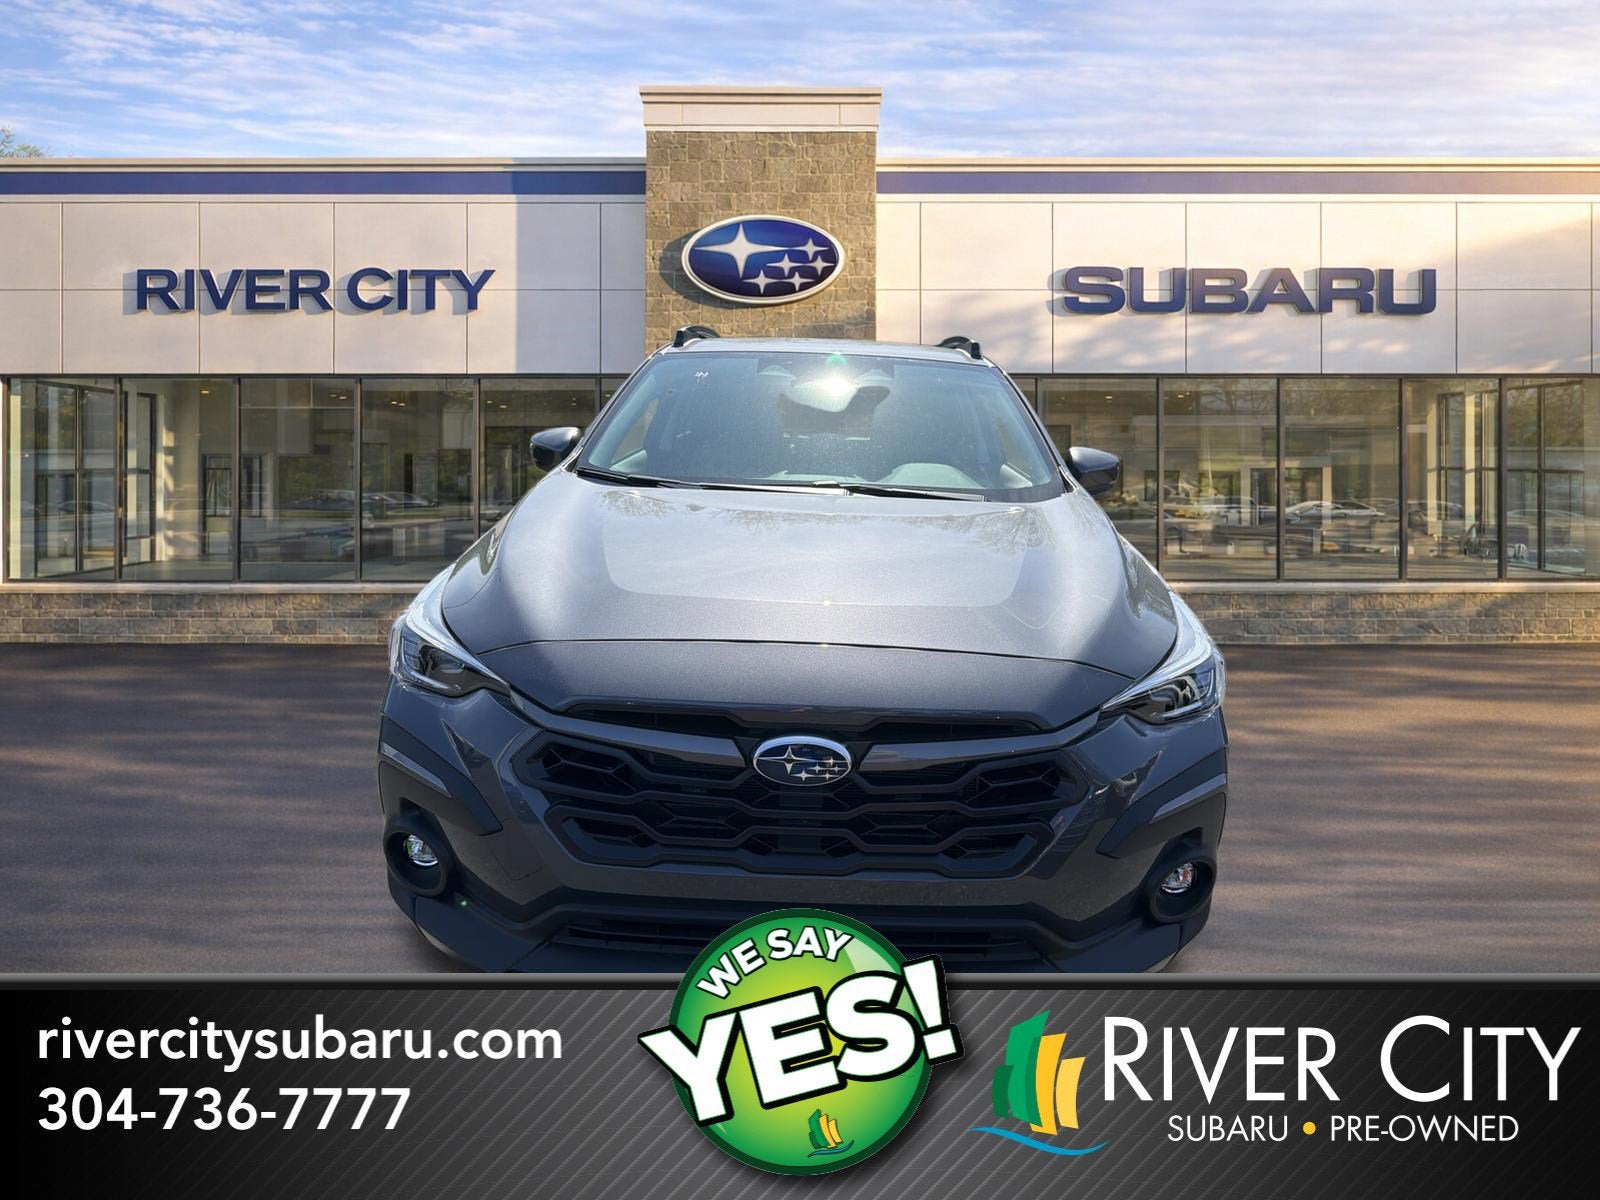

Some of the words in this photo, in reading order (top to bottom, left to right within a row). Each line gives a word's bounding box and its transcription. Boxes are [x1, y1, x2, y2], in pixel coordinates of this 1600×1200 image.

[136, 268, 333, 312] RIVER
[346, 267, 496, 312] CITY
[1062, 266, 1437, 315] SUBARU
